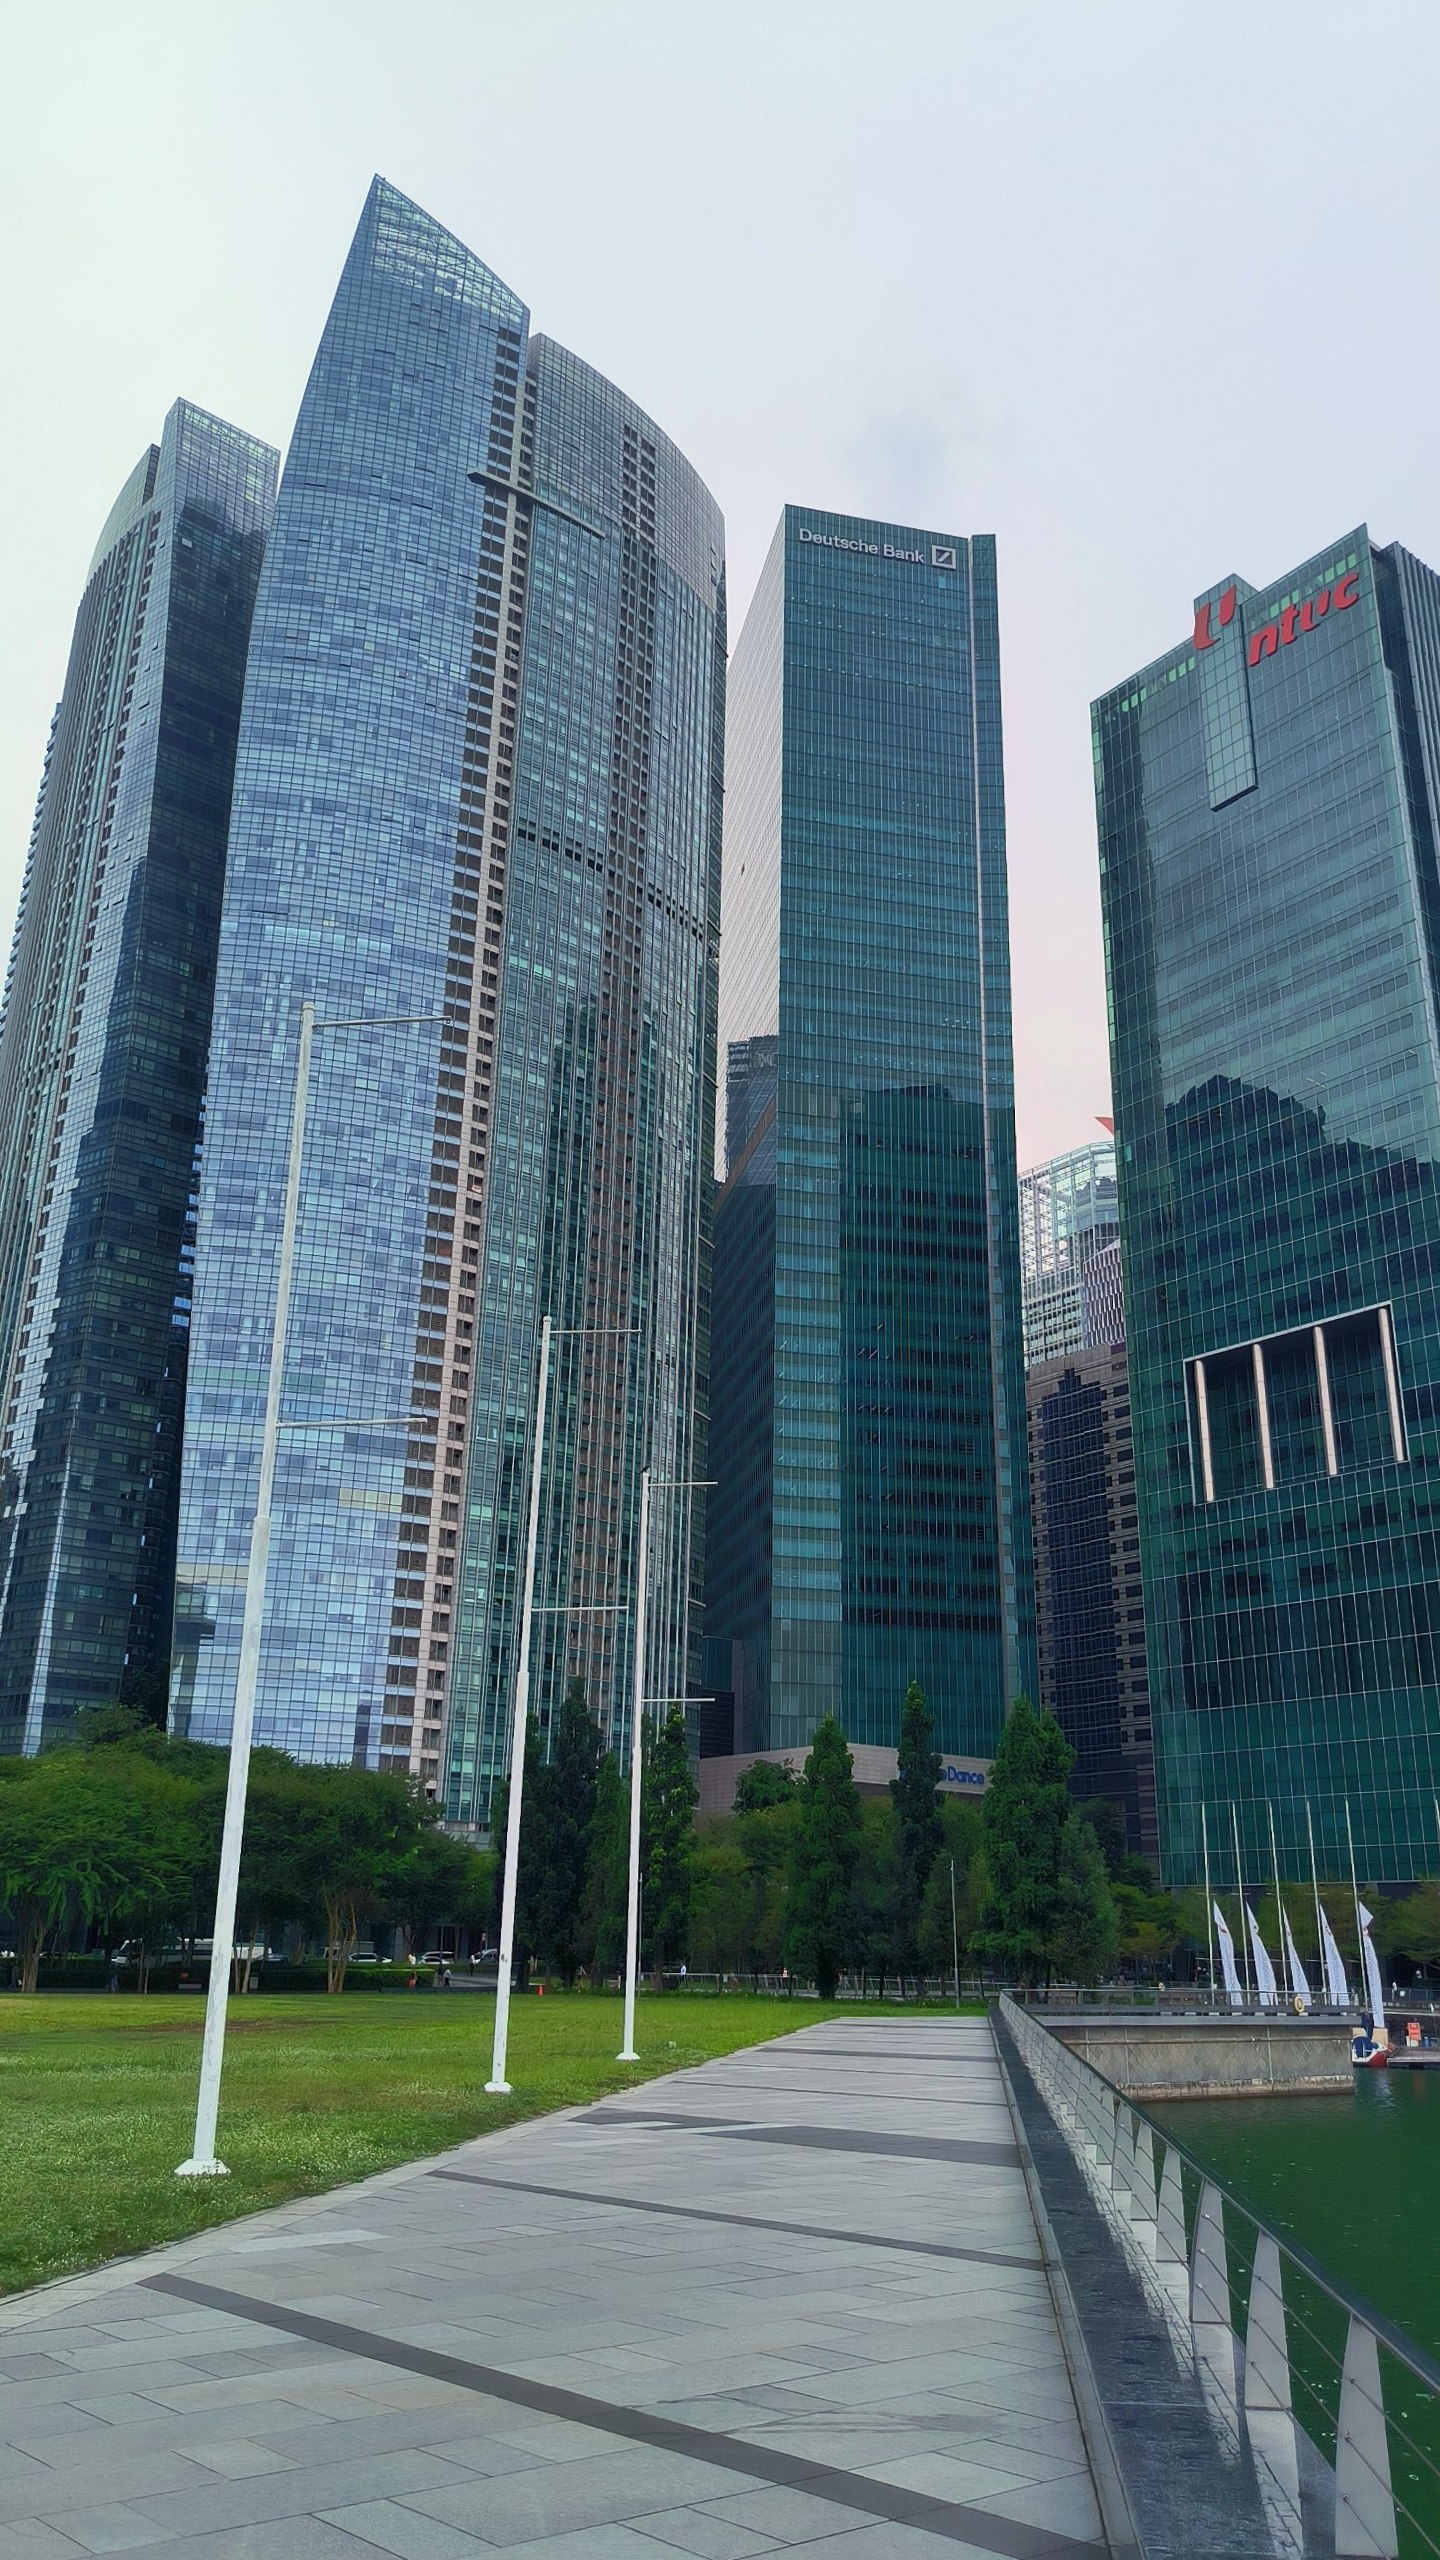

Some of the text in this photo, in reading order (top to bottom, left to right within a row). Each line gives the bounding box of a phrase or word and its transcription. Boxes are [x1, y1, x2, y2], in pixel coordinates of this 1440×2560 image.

[799, 527, 925, 563] Deutsche Bank
[1248, 573, 1359, 667] ntuc
